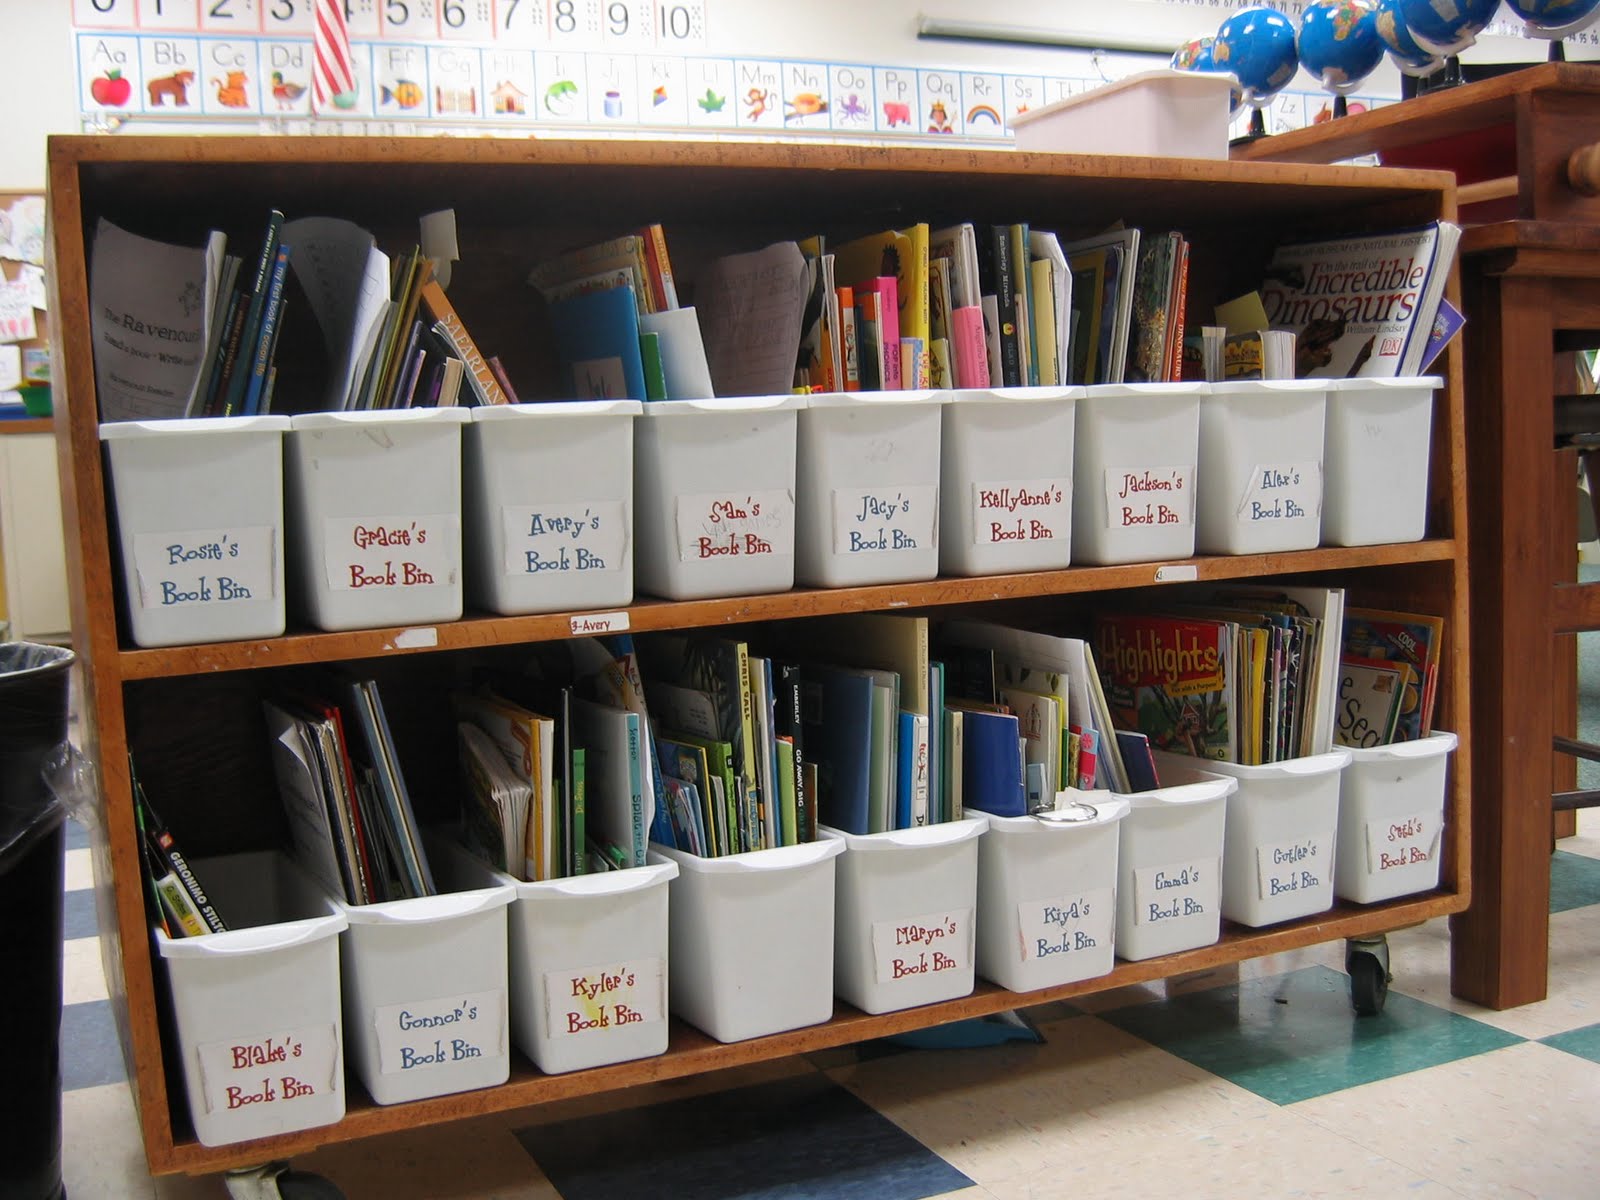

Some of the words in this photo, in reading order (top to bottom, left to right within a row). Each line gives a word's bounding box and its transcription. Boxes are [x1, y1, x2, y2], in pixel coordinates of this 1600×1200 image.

[387, 0, 409, 26] 5
[443, 0, 465, 28] 6
[500, 0, 519, 30] 7
[555, 0, 576, 32] 8
[608, 2, 629, 36] 9
[661, 5, 690, 39] 10
[92, 40, 127, 65] Aa
[153, 41, 187, 65] Bb
[211, 43, 246, 68] Cc
[270, 45, 304, 69] Dd
[388, 48, 415, 73] Ff
[437, 52, 471, 82] Gg
[652, 59, 671, 79] Kk
[742, 65, 776, 85] Mm
[793, 67, 818, 88] Nn
[836, 68, 865, 90] Oo
[885, 71, 907, 101] Pp
[926, 73, 957, 103] Qq
[974, 77, 991, 97] Rr
[1014, 80, 1032, 99] Ss
[1279, 95, 1296, 114] Zz
[998, 235, 1007, 271] Emberley
[1334, 261, 1348, 272] the
[274, 266, 284, 280] my
[1302, 257, 1424, 295] Incredible
[271, 282, 283, 299] first
[266, 299, 279, 322] book
[1262, 288, 1418, 327] Dinosaurs
[264, 323, 273, 333] of
[974, 324, 983, 359] Angelina
[1346, 324, 1375, 334] William
[1376, 323, 1407, 334] Lindsay
[443, 313, 486, 375] SAFARI
[1172, 323, 1185, 377] DINOSAURS
[1383, 340, 1400, 354] DK
[1119, 471, 1183, 499] Jackson's
[1261, 467, 1300, 490] Alex's
[709, 496, 760, 523] Sam's
[856, 493, 909, 522] Jacy's
[1121, 504, 1153, 526] Book
[1158, 504, 1179, 524] Bin
[1251, 498, 1281, 521] Book
[1284, 499, 1305, 518] Bin
[354, 522, 426, 549] Gracie's
[528, 509, 599, 538] Avery's
[990, 519, 1025, 542] Book
[1029, 520, 1053, 540] Bin
[167, 535, 239, 565] Rosie's
[698, 532, 739, 558] Book
[744, 533, 772, 555] Bin
[849, 528, 888, 552] Book
[892, 529, 917, 550] Bin
[525, 547, 569, 573] Book
[575, 548, 605, 571] Bin
[350, 561, 396, 588] Book
[402, 562, 434, 586] Bin
[161, 577, 212, 605] Book
[217, 577, 251, 601] Bin
[571, 618, 611, 632] 3-Avery
[1102, 624, 1219, 684] Highlights
[1398, 632, 1417, 653] COOL
[739, 652, 749, 687] CHRIS
[1340, 677, 1353, 700] e
[741, 691, 751, 721] GALL
[791, 684, 802, 724] EMBERLEY
[795, 749, 802, 762] GO
[632, 794, 644, 830] Splat
[796, 791, 804, 807] BIG
[1387, 817, 1422, 842] Seth's
[1380, 847, 1406, 870] Book
[1410, 846, 1428, 863] Bin
[1155, 866, 1199, 891] Emma's
[1270, 872, 1298, 896] Book
[1301, 871, 1319, 888] Bin
[169, 851, 207, 903] GERONIMO
[203, 904, 226, 934] STILTO
[1043, 898, 1090, 927] Kiya's
[1149, 899, 1180, 922] Book
[1183, 897, 1204, 915] Bin
[896, 916, 956, 946] Maryn's
[1036, 932, 1071, 958] Book
[1074, 931, 1096, 951] Bin
[892, 953, 929, 979] Book
[933, 951, 956, 972] Bin
[571, 967, 635, 1000] Kyler's
[566, 1005, 609, 1033] Book
[614, 1004, 643, 1026] Bin
[231, 1037, 302, 1069] Blake's
[400, 1040, 445, 1069] Book
[451, 1039, 482, 1061] Bin
[226, 1078, 275, 1109] Book
[280, 1076, 314, 1100] Bin
